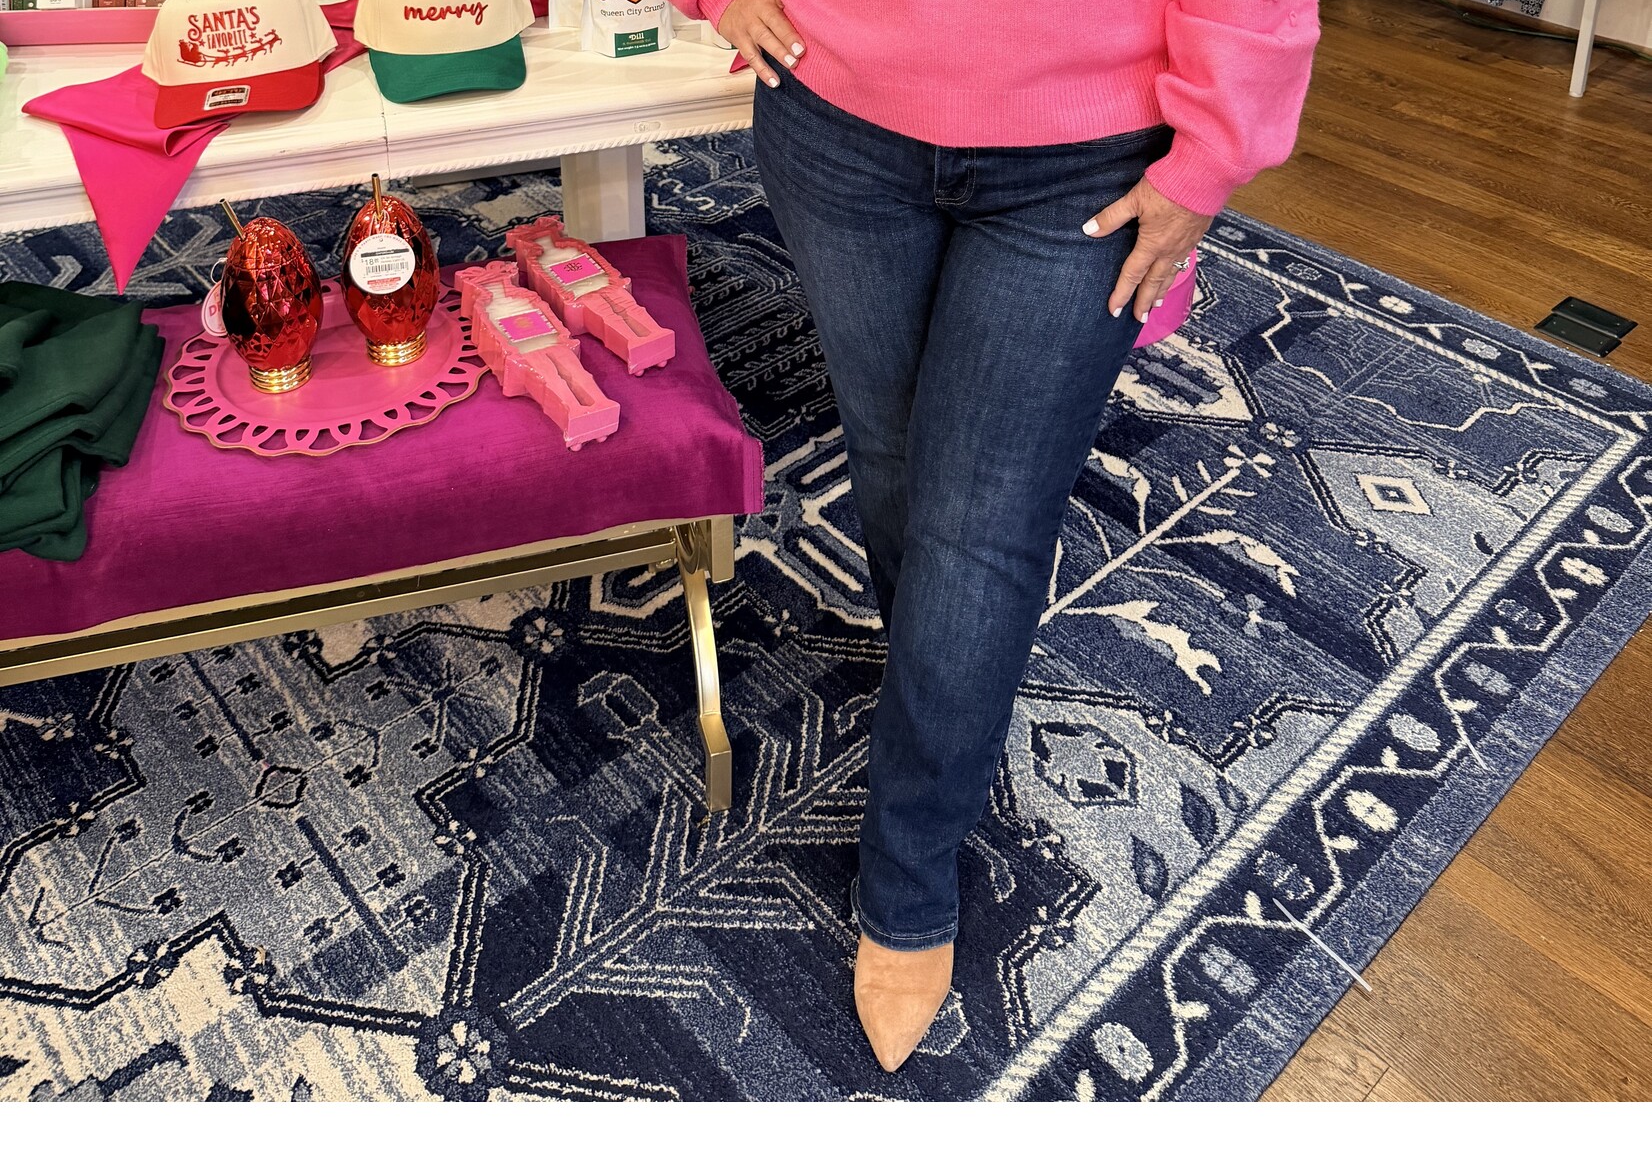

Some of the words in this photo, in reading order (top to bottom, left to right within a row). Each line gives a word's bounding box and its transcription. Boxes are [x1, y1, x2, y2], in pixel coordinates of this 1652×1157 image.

[404, 2, 488, 25] merry
[601, 9, 624, 17] Queen
[626, 8, 642, 16] City
[187, 6, 260, 41] SANTA'S
[207, 29, 248, 50] FAVORITE
[629, 32, 644, 41] Dill
